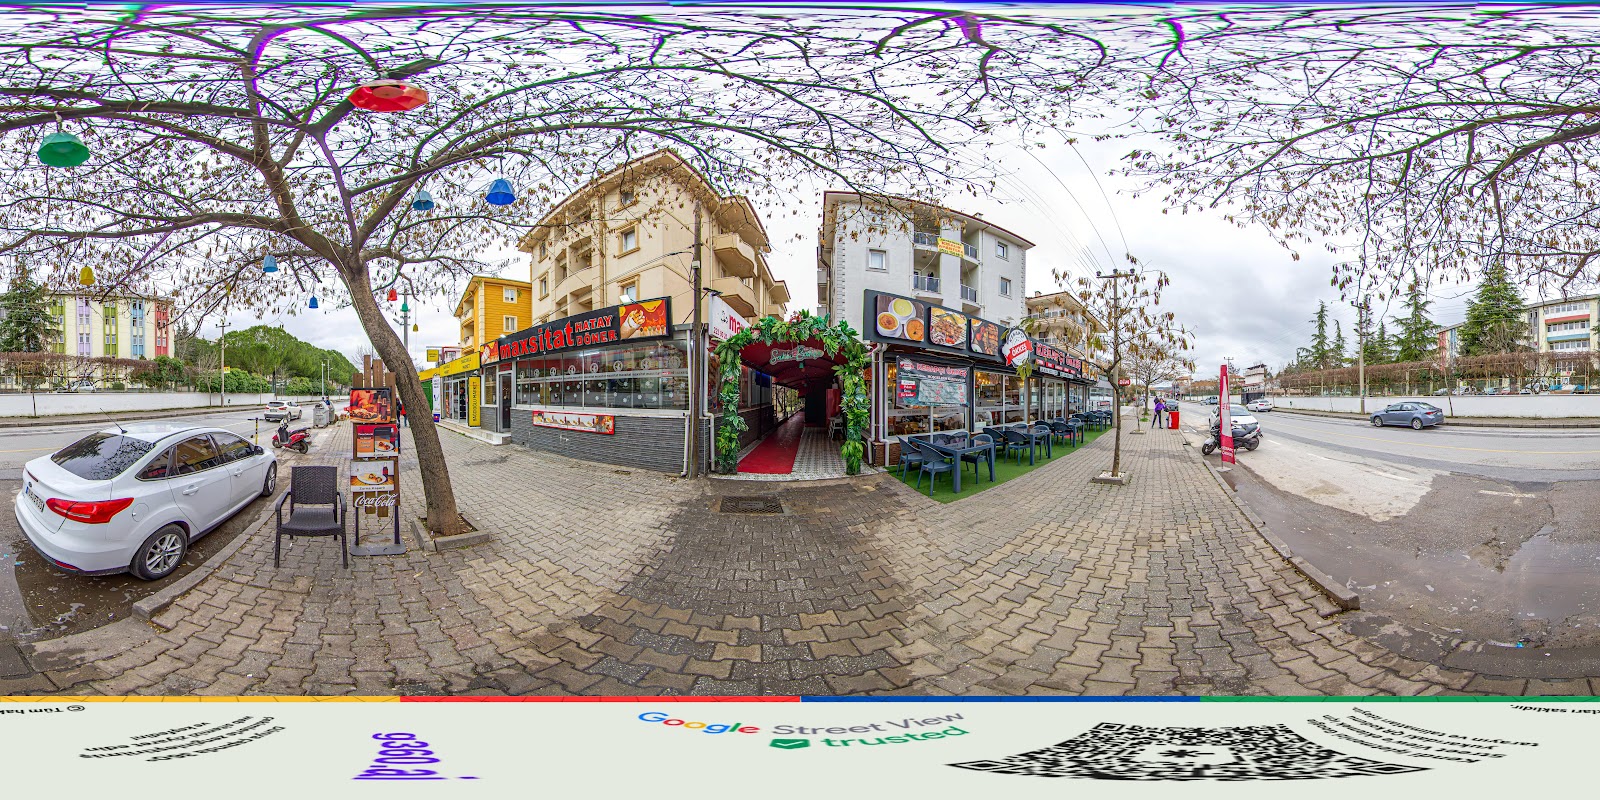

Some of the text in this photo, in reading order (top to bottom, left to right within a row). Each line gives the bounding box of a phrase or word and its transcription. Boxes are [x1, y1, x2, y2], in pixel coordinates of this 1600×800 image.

[575, 315, 613, 333] HATAY
[500, 320, 575, 360] maxsitat
[576, 329, 618, 347] DÖNER
